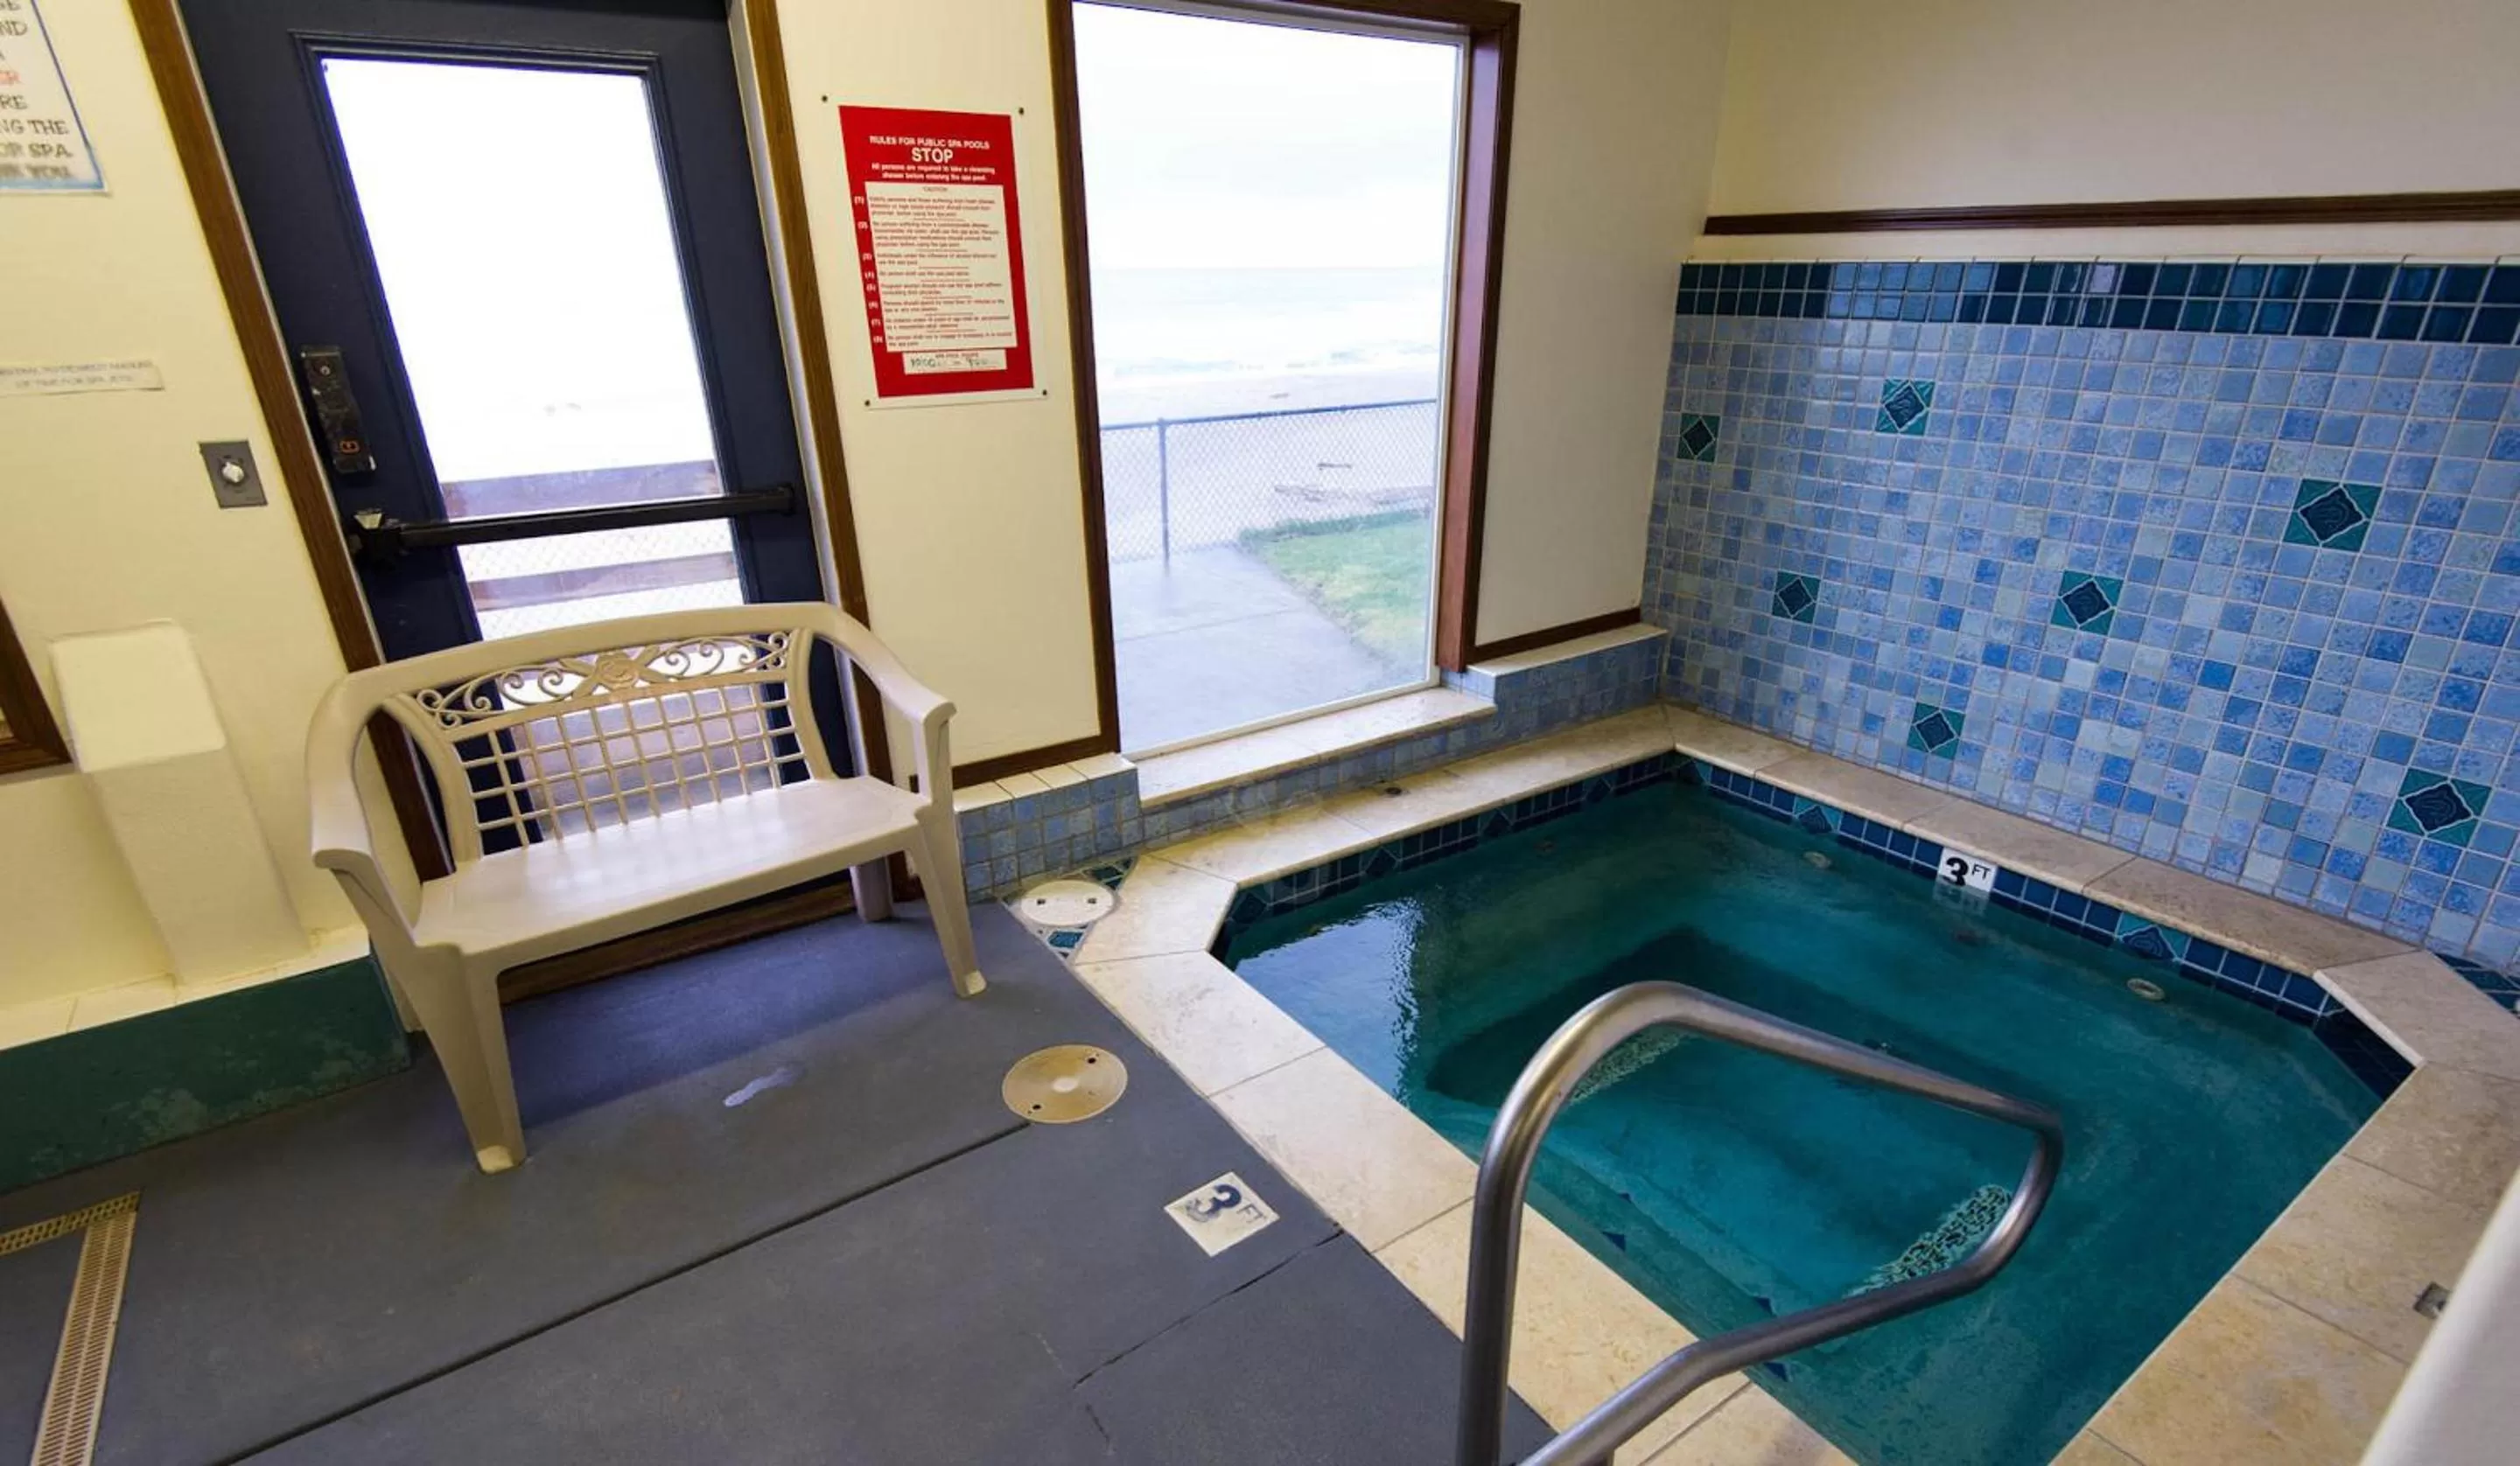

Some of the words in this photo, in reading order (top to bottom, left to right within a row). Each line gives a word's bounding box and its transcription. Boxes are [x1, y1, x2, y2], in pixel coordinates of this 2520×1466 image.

[27, 119, 69, 135] THE
[869, 136, 897, 145] RULES
[899, 136, 915, 146] FOR
[917, 137, 946, 147] PUBLIC
[948, 139, 962, 148] SPA
[963, 140, 990, 150] POOLS
[912, 147, 953, 164] STOP
[1942, 856, 1969, 886] 3
[1971, 863, 1991, 880] FT
[1185, 1183, 1242, 1223] 3
[1236, 1203, 1266, 1223] FT
